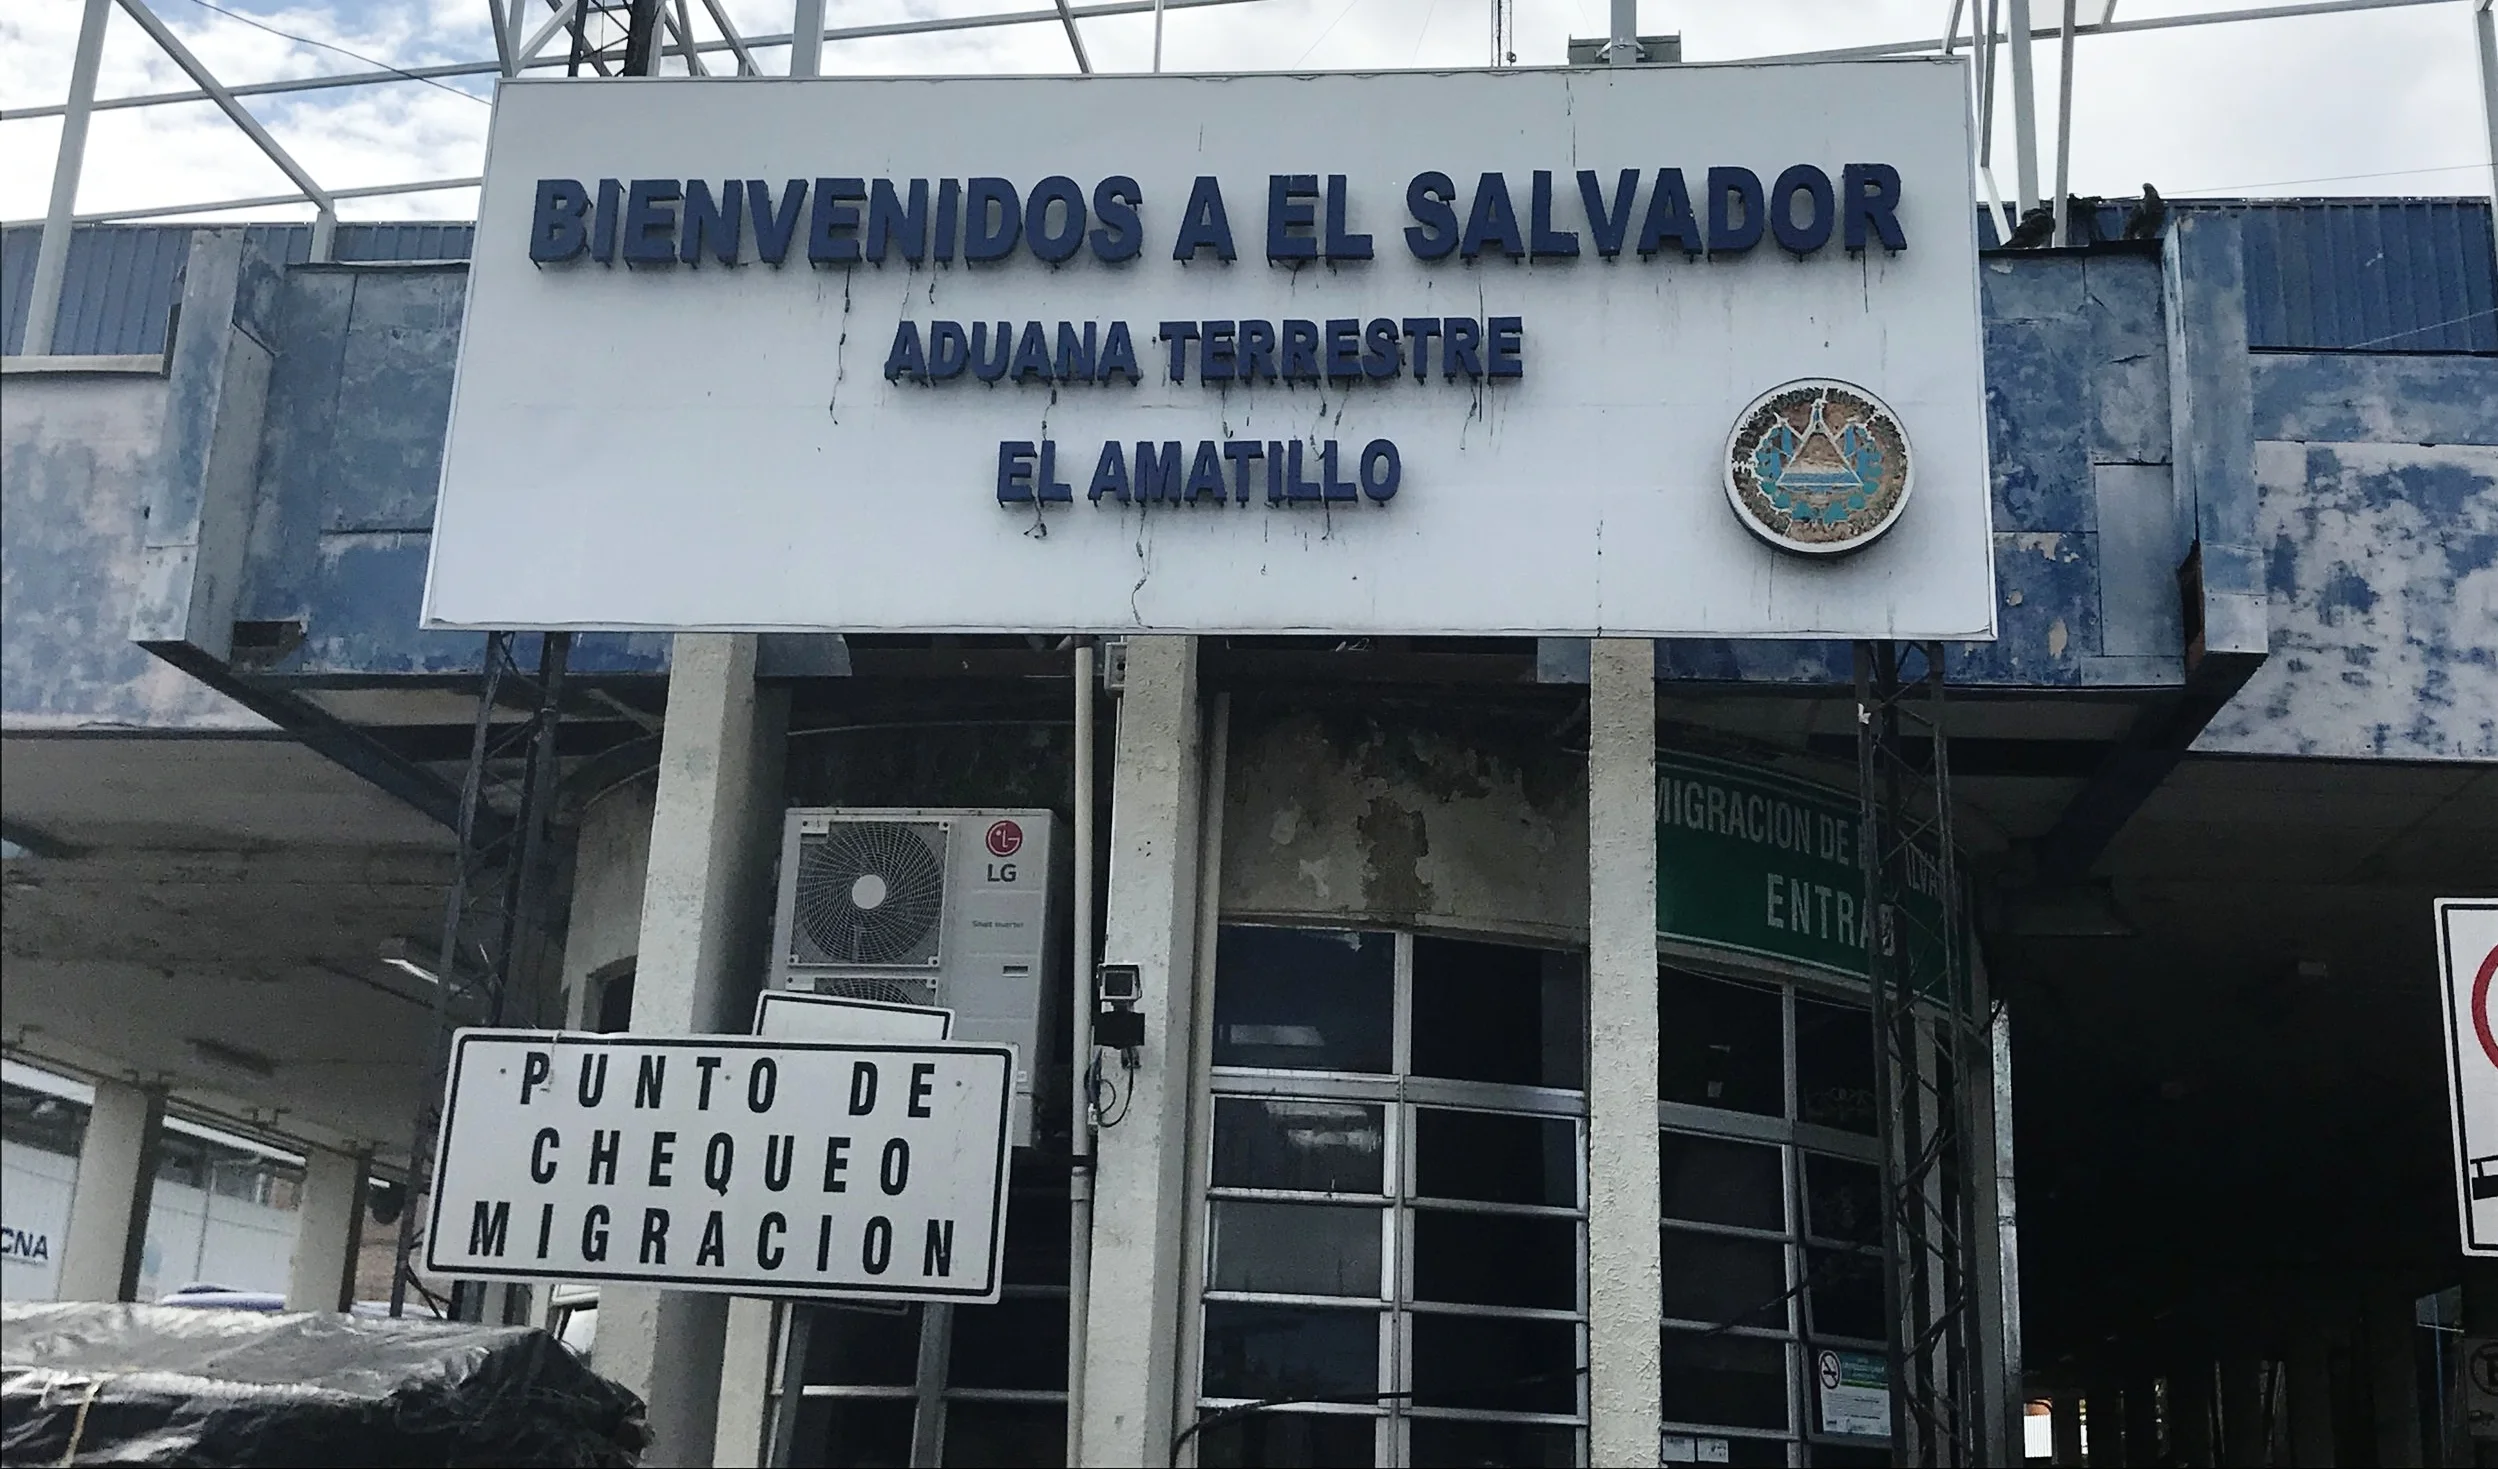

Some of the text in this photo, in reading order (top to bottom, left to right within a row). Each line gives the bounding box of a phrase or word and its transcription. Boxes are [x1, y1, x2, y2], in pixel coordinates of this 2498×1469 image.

[528, 163, 1908, 266] BIENVENIDOS A EL SALVADOR
[884, 316, 1524, 385] ADUANA TERRESTRE
[996, 438, 1402, 506] EL AMATILLO
[1655, 777, 1812, 855] MIGRACION
[1820, 813, 1850, 867] DE
[987, 863, 1017, 883] LG
[521, 1051, 936, 1119] PUNTO DE
[530, 1127, 910, 1197] CHEQUEO
[469, 1200, 955, 1278] MIGRACION
